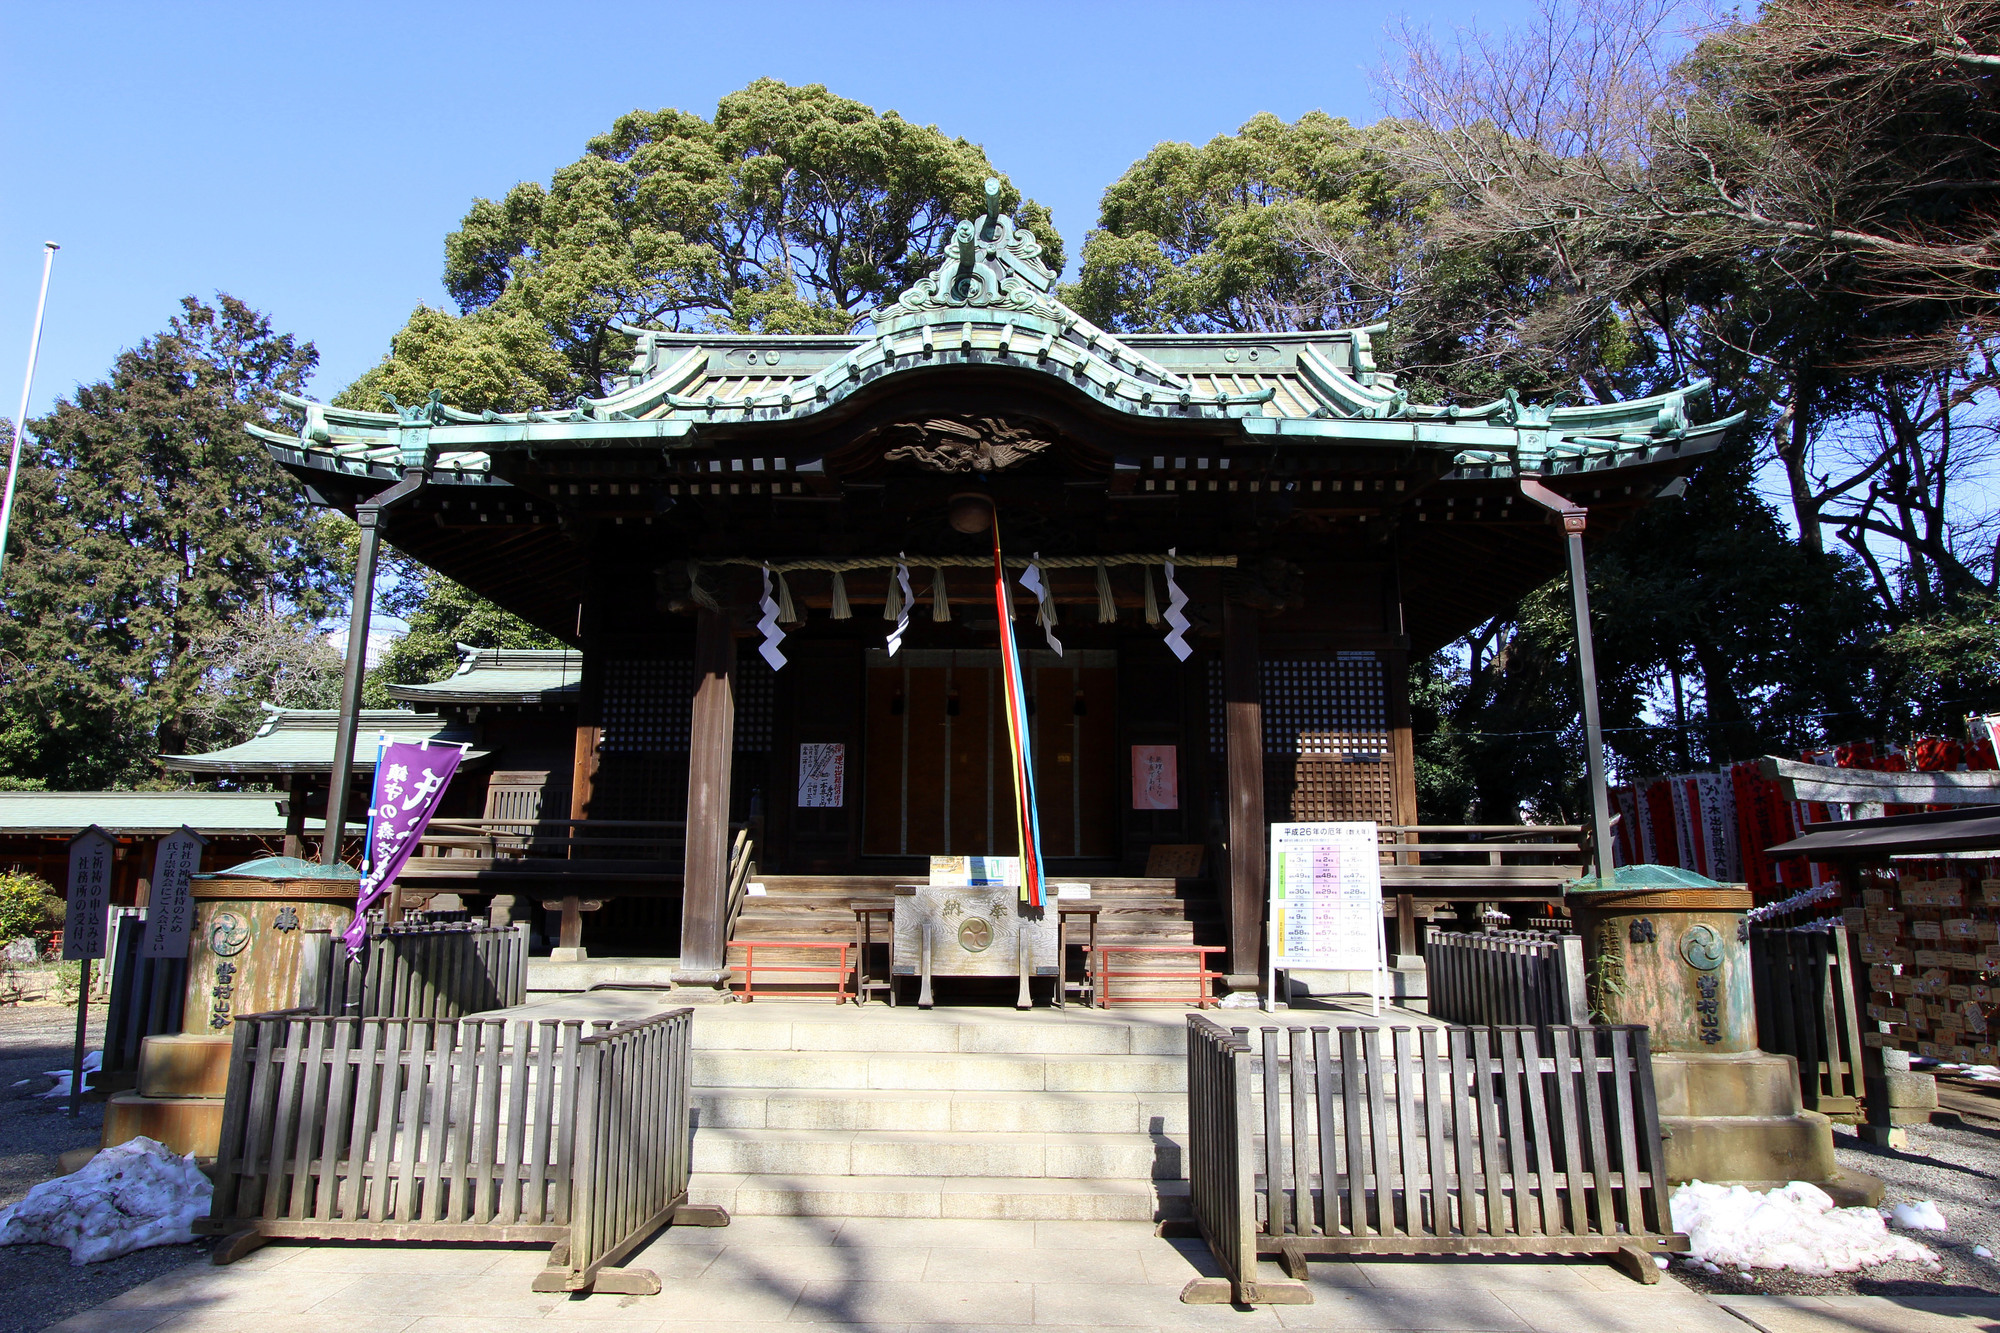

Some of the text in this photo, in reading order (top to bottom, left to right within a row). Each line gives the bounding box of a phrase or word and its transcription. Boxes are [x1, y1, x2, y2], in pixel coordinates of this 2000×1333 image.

[1284, 828, 1342, 836] 平成26年の厄年
[72, 856, 89, 950] 社務所の受付へ
[86, 842, 105, 953] ご祈祷の申込みは
[153, 842, 178, 951] 氏子崇敬会にご入会下さい
